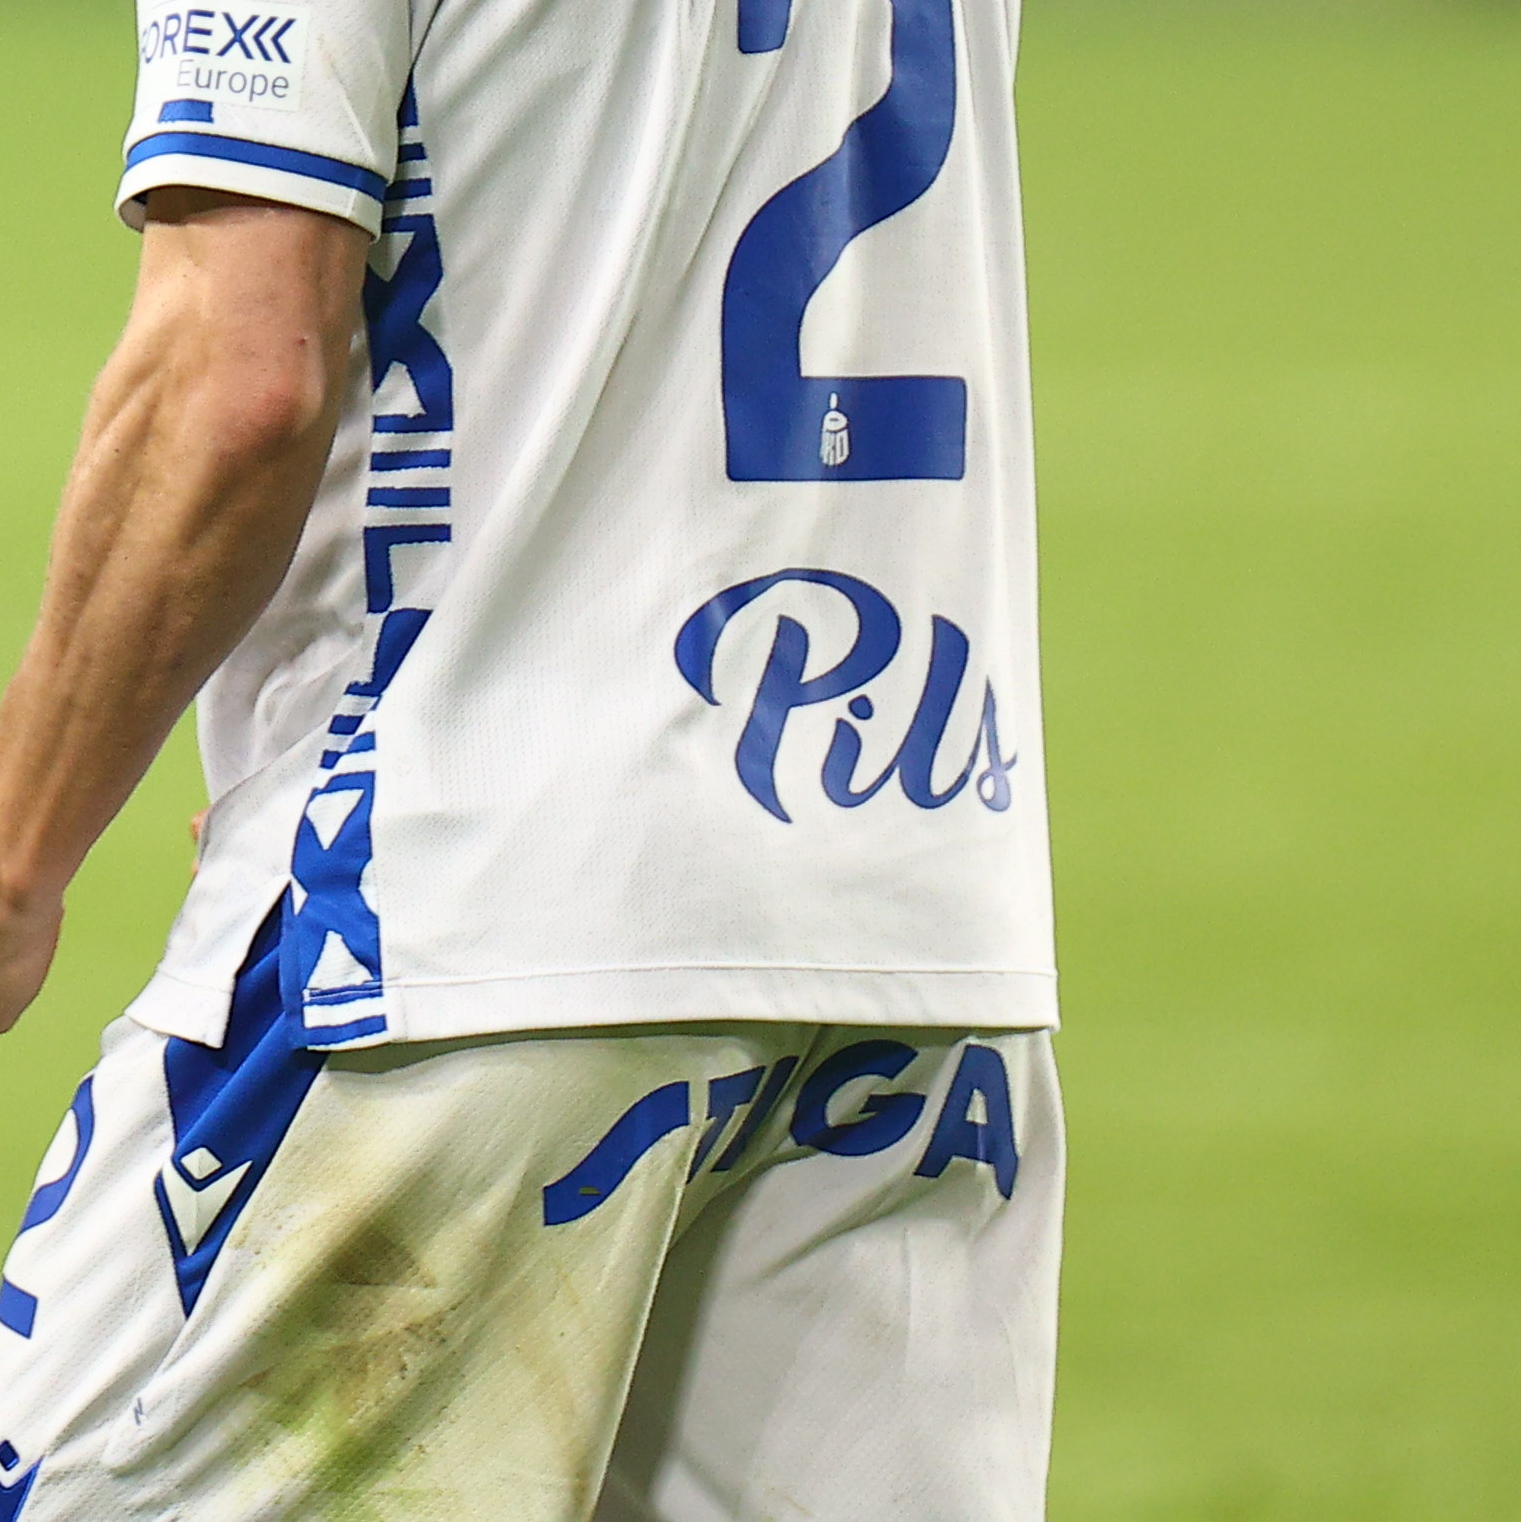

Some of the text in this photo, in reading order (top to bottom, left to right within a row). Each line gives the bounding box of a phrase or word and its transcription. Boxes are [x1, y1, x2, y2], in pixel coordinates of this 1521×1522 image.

[141, 8, 261, 65] OREX
[176, 59, 290, 103] Europe
[673, 566, 1019, 824] Pils
